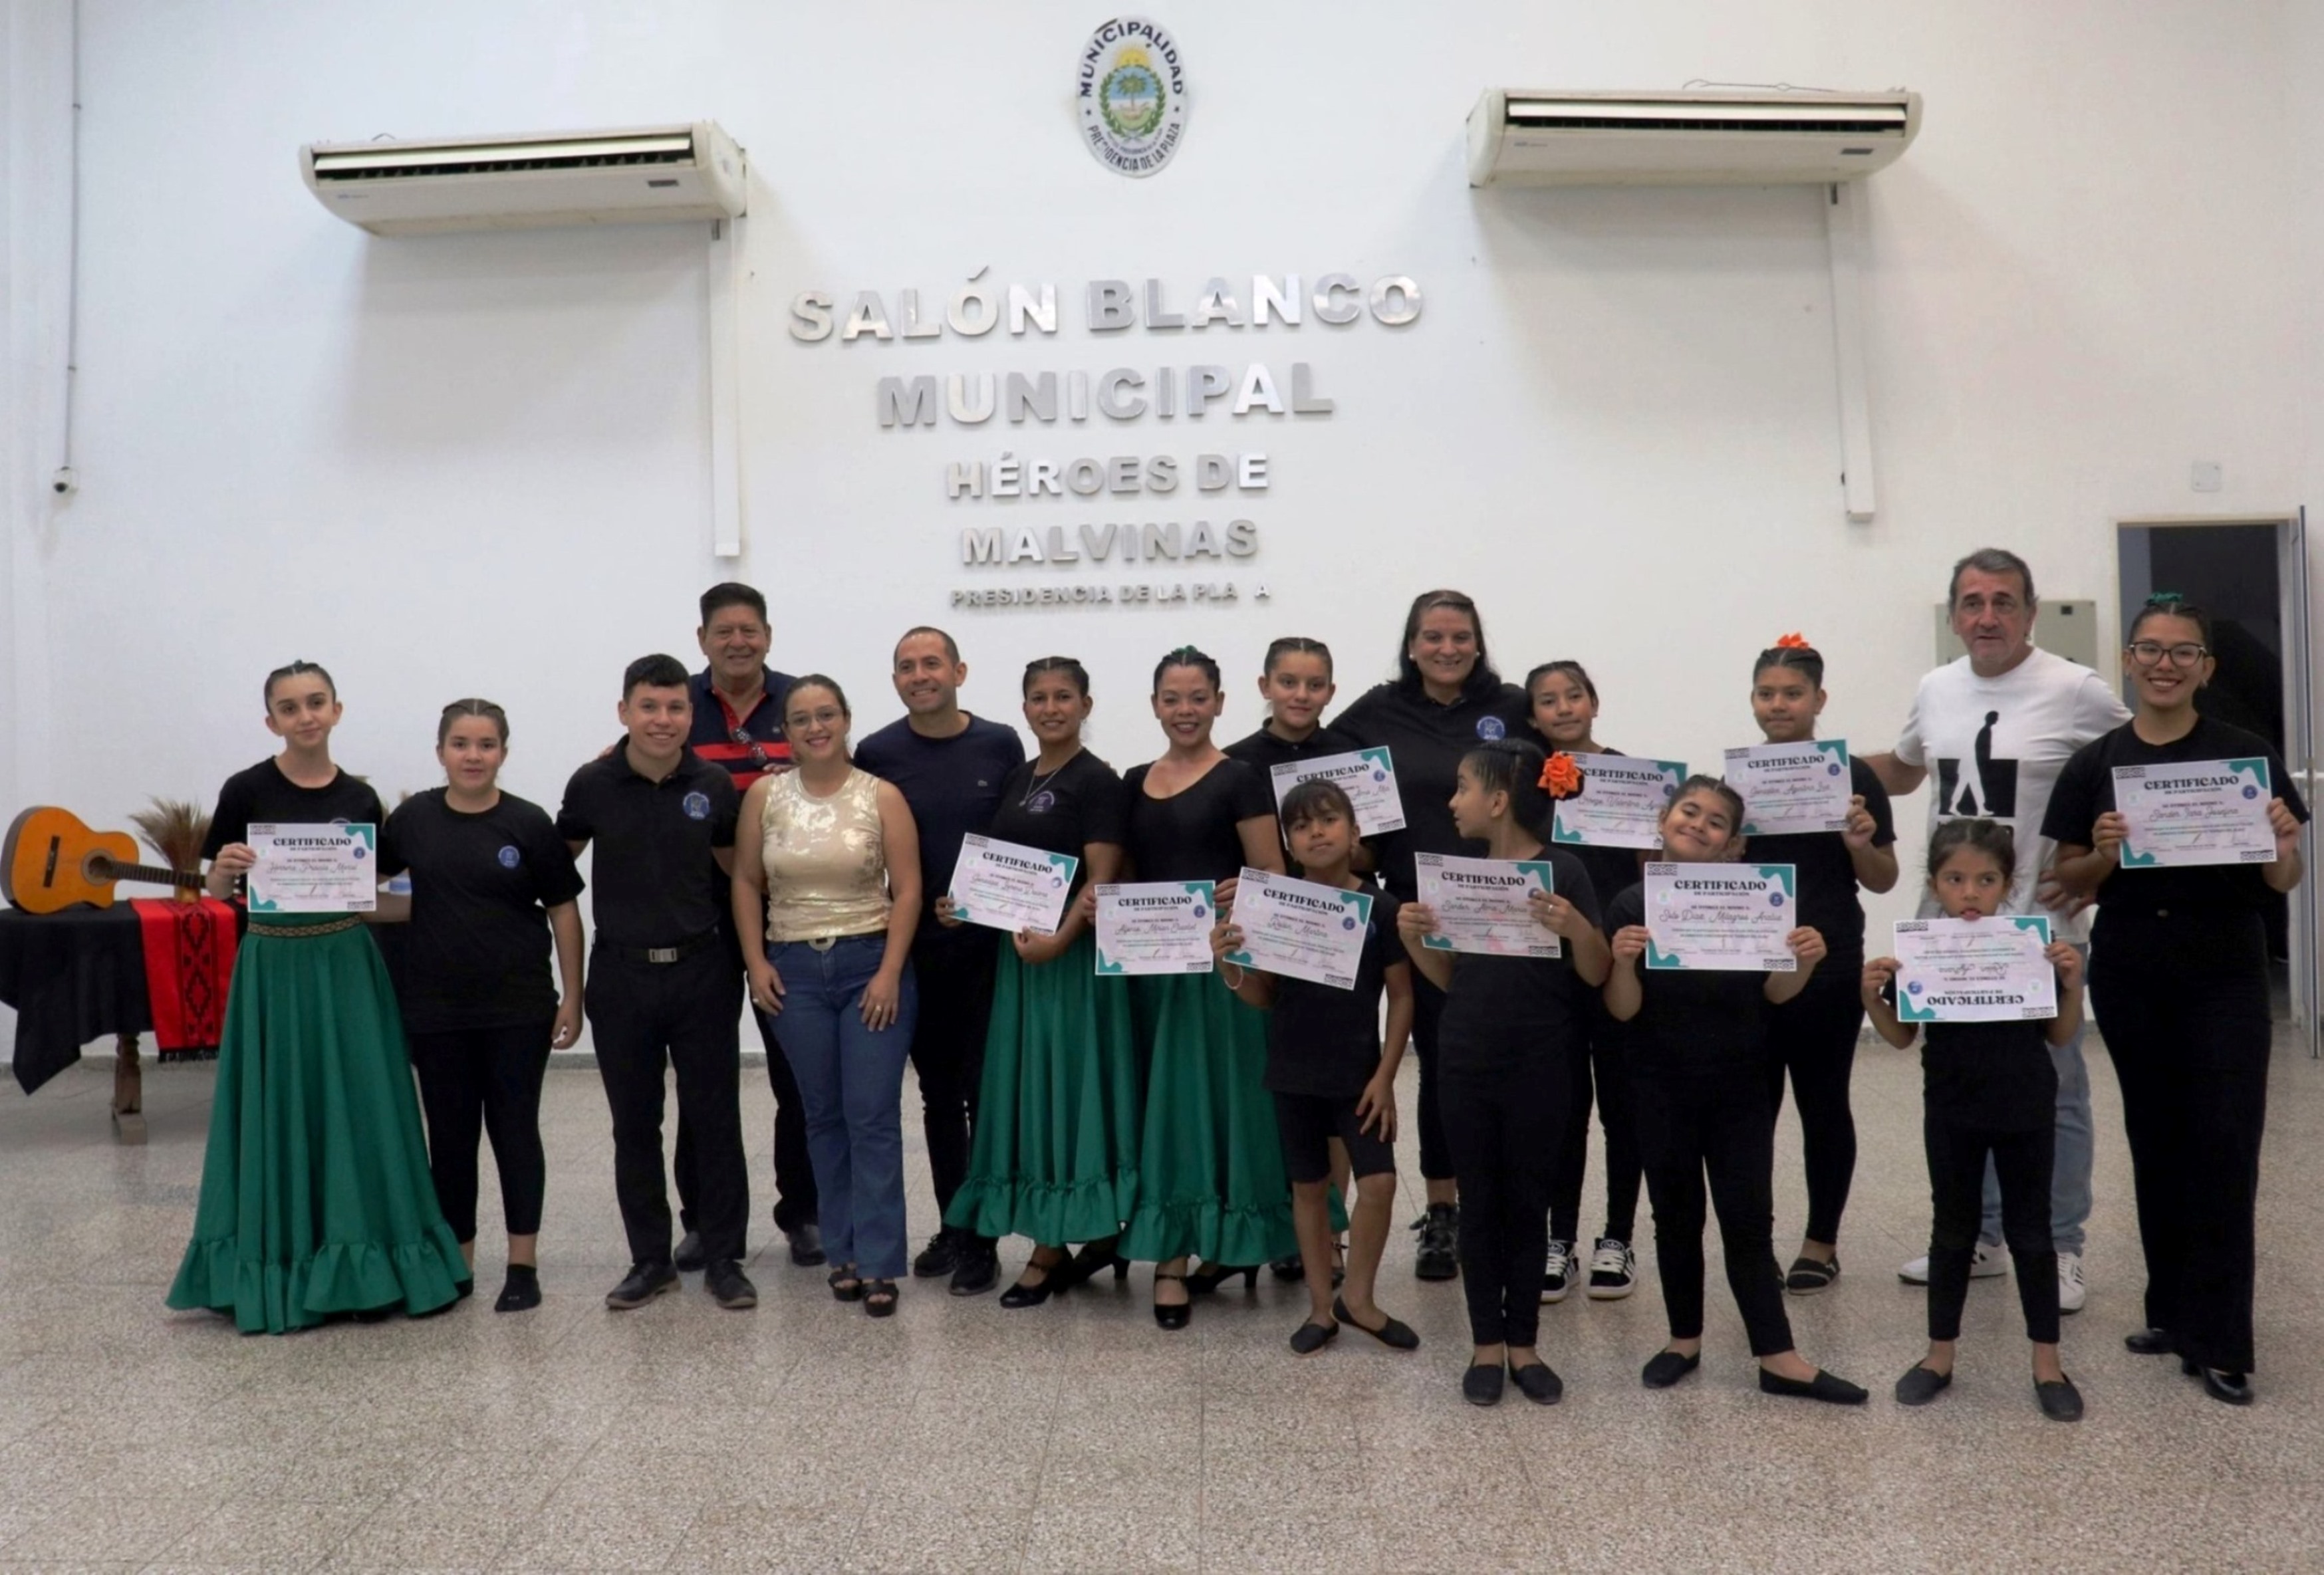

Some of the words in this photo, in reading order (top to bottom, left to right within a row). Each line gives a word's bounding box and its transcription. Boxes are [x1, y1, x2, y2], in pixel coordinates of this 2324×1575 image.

[1081, 21, 1183, 97] MUNICIPALIDAD
[1140, 155, 1154, 170] DE
[1152, 149, 1165, 164] LA
[1160, 122, 1180, 152] PLAZA
[789, 265, 1057, 342] SALÓN
[1087, 273, 1423, 330] BLANCO
[878, 363, 1335, 427] MUNICIPAL
[948, 452, 1178, 497] HÉROES
[1197, 453, 1268, 491] DE
[962, 519, 1258, 564] MALVINAS
[950, 584, 1112, 608] PRESIDENCIA
[1119, 584, 1150, 602] DE
[1157, 583, 1186, 601] LA
[1747, 755, 1825, 769] CERTIFICADO
[1583, 768, 1663, 782] CERTIFICADO
[2144, 775, 2239, 790] CERTIFICADO
[273, 837, 352, 846] CERTIFICADO
[983, 851, 1053, 874] CERTIFICADO
[1441, 872, 1525, 886] CERTIFICADO
[1674, 880, 1767, 891] CERTIFICADO
[1118, 896, 1192, 907] CERTIFICADO
[1263, 888, 1345, 913] CERTIFICADO
[1927, 995, 2024, 1005] CERTIFICADO
